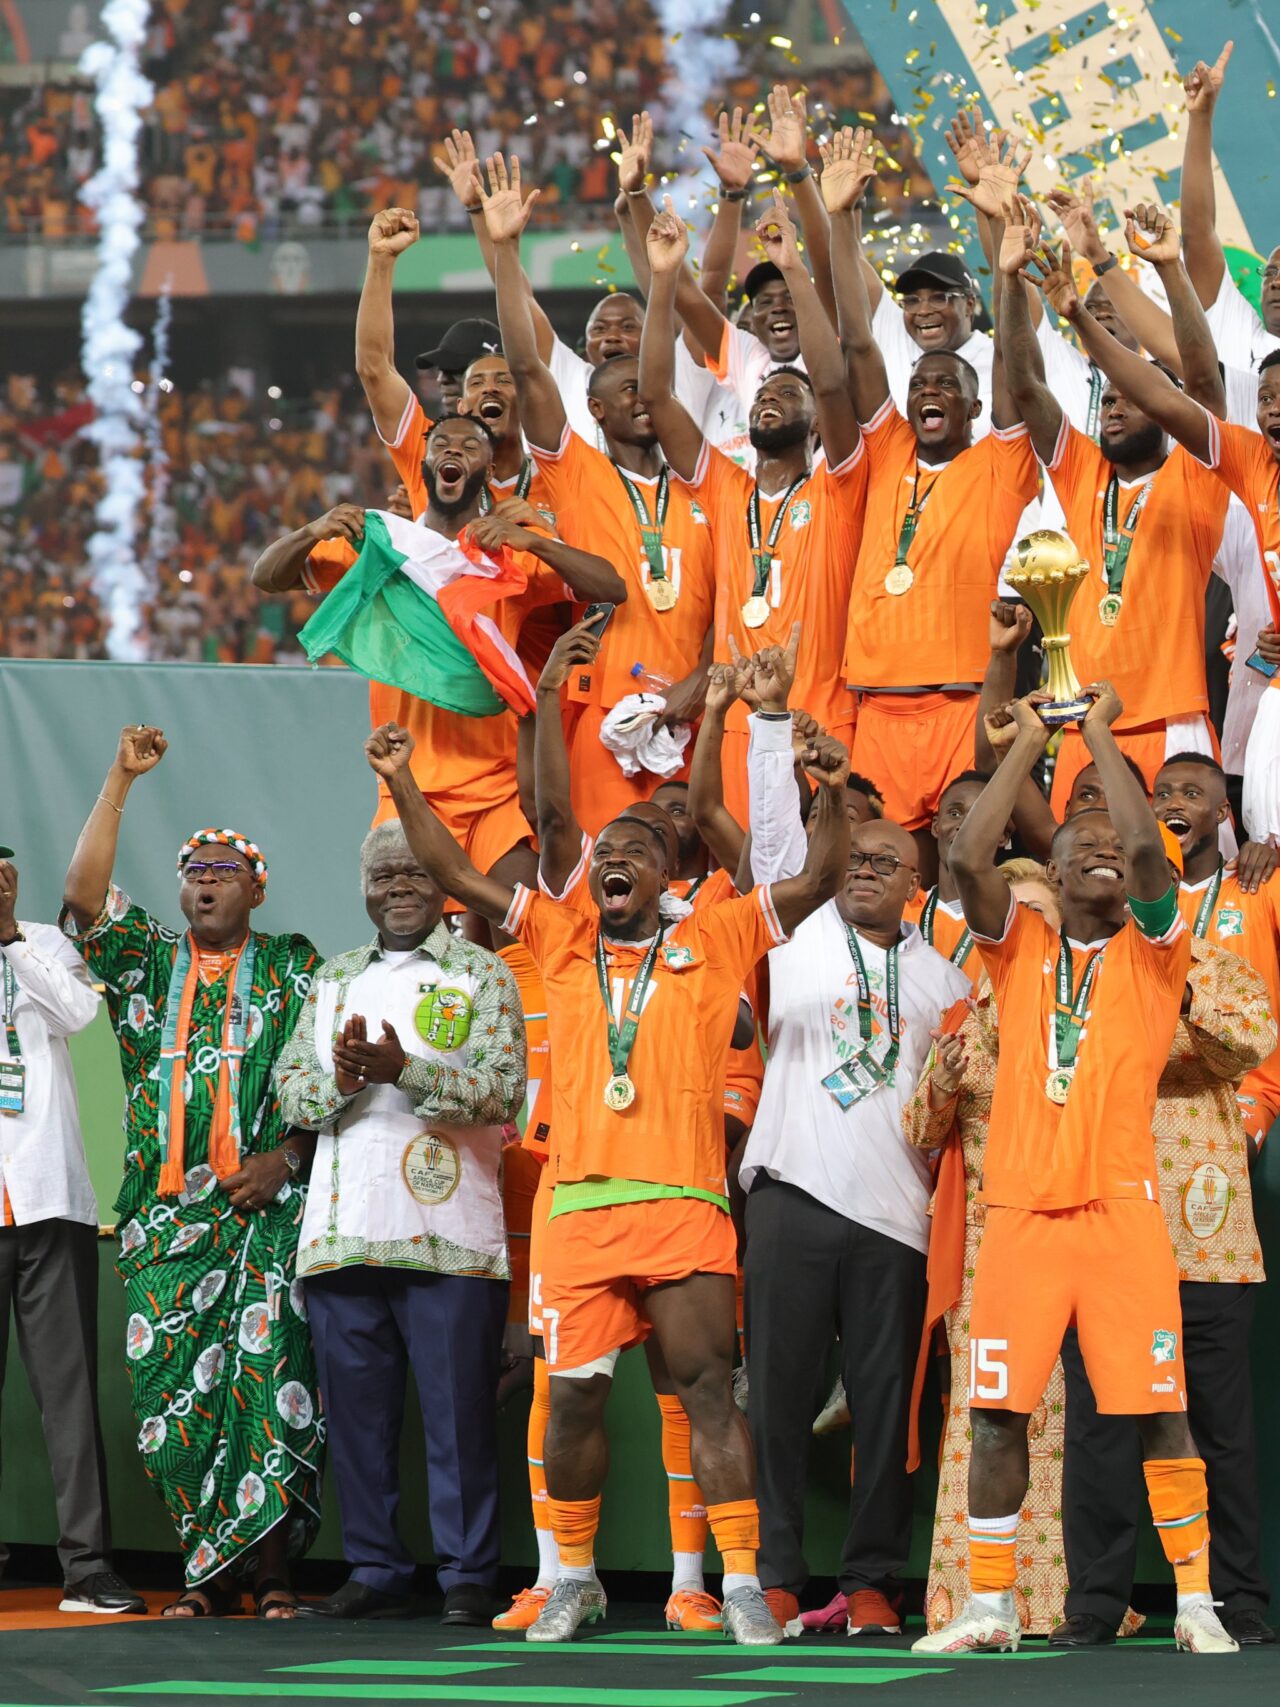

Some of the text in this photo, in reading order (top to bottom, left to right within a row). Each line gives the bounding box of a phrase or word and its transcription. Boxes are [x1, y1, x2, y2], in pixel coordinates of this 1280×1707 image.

[1199, 903, 1209, 921] AFRICA
[639, 962, 649, 981] AFRICA
[853, 955, 862, 973] AFRICA
[970, 1338, 1008, 1400] 15
